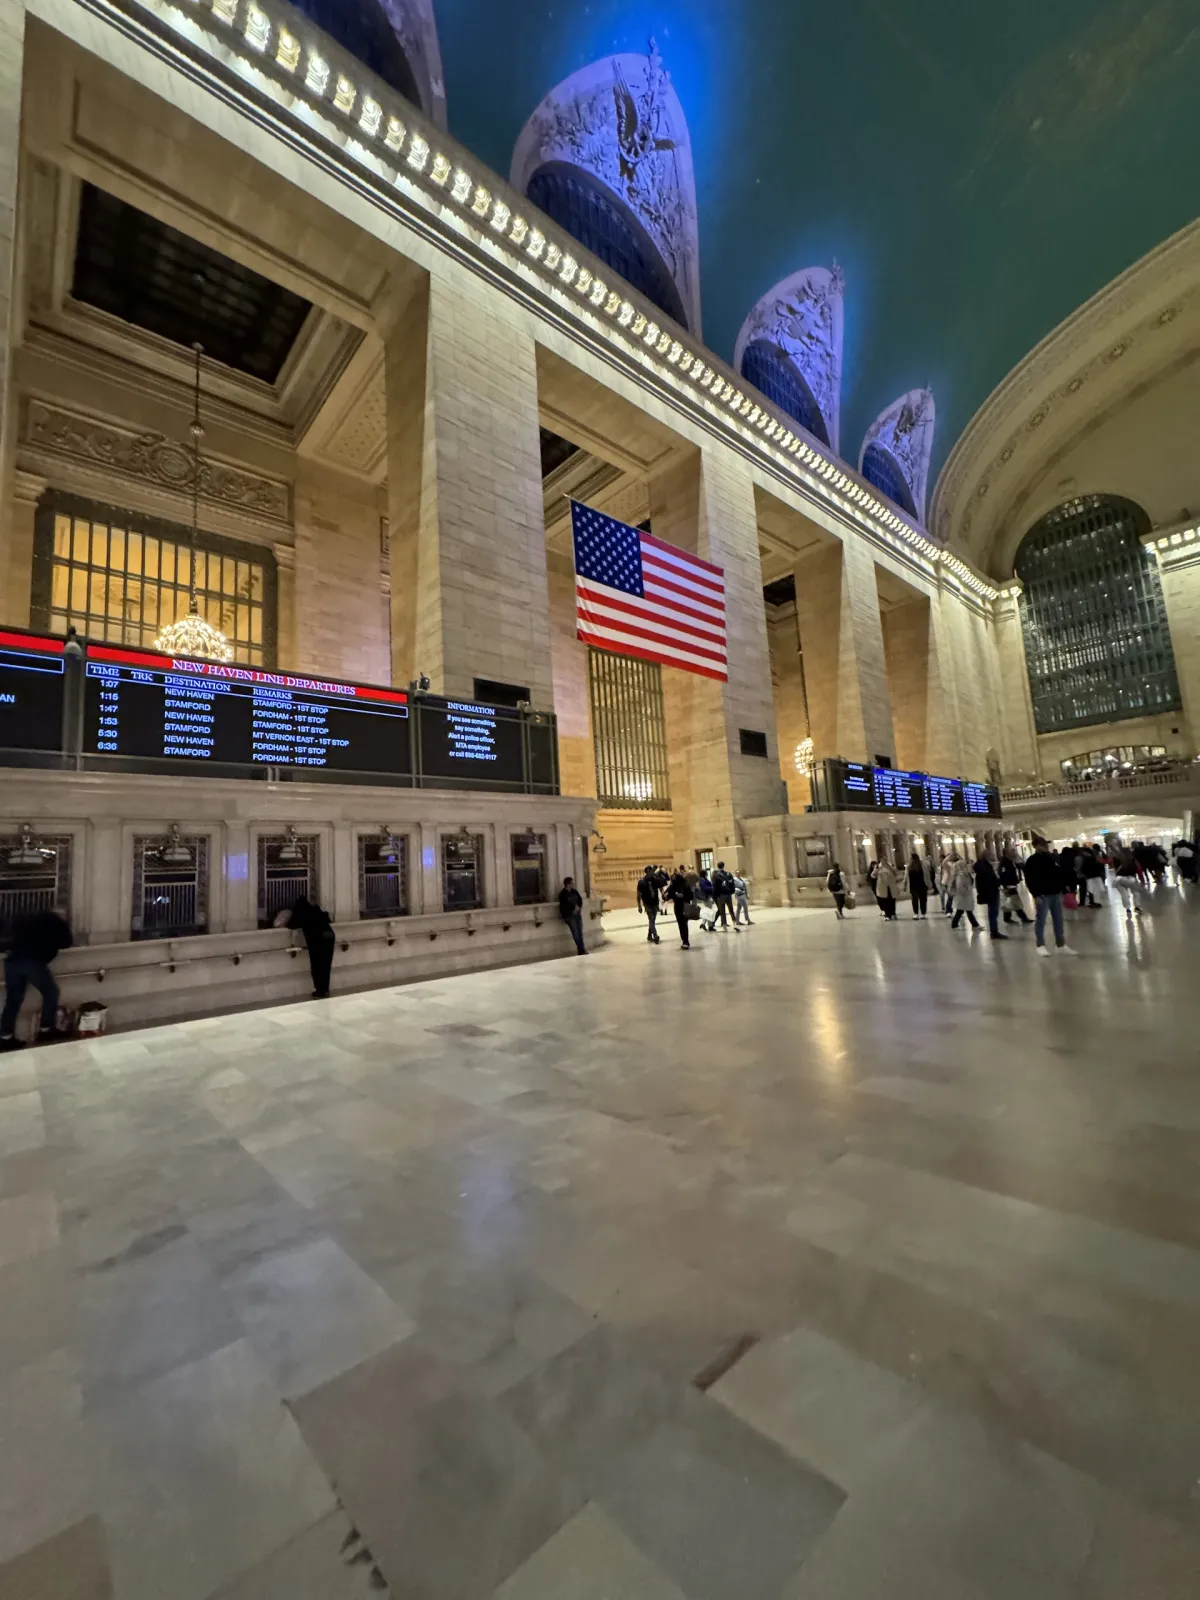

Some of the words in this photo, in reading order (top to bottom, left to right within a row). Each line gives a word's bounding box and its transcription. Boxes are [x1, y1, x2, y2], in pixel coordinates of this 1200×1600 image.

[90, 666, 120, 676] TIME
[131, 671, 153, 681] TRK
[172, 660, 205, 674] NEW
[208, 664, 253, 680] HAVEN
[256, 672, 284, 684] LINE
[286, 677, 356, 695] DEPARTURES
[100, 680, 118, 688] 1:07
[165, 676, 230, 692] DESTINATION
[165, 688, 185, 697] NEW
[187, 690, 214, 700] HAVEN
[253, 688, 292, 700] REMARKS
[100, 704, 118, 713] 1:47
[165, 700, 211, 711] STAMFORD
[252, 700, 292, 710] STAMFORD
[297, 704, 310, 712] 1ST
[310, 706, 328, 714] STOP
[447, 702, 495, 715] INFORMATION
[99, 716, 118, 726] 1:53
[164, 712, 185, 720] NEW
[186, 714, 214, 723] HAVEN
[252, 710, 288, 720] FORDHAM
[294, 714, 306, 722] 1ST
[308, 716, 326, 724] STOP
[164, 723, 210, 734] STAMFORD
[252, 720, 292, 731] STAMFORD
[297, 725, 310, 733] 1ST
[311, 726, 329, 734] STOP
[98, 729, 118, 738] 5:30
[264, 733, 295, 742] VERNON
[164, 734, 185, 744] NEW
[186, 736, 214, 746] HAVEN
[164, 746, 210, 757] STAMFORD
[252, 742, 289, 752] FORDHAM
[252, 754, 289, 763] FORDHAM
